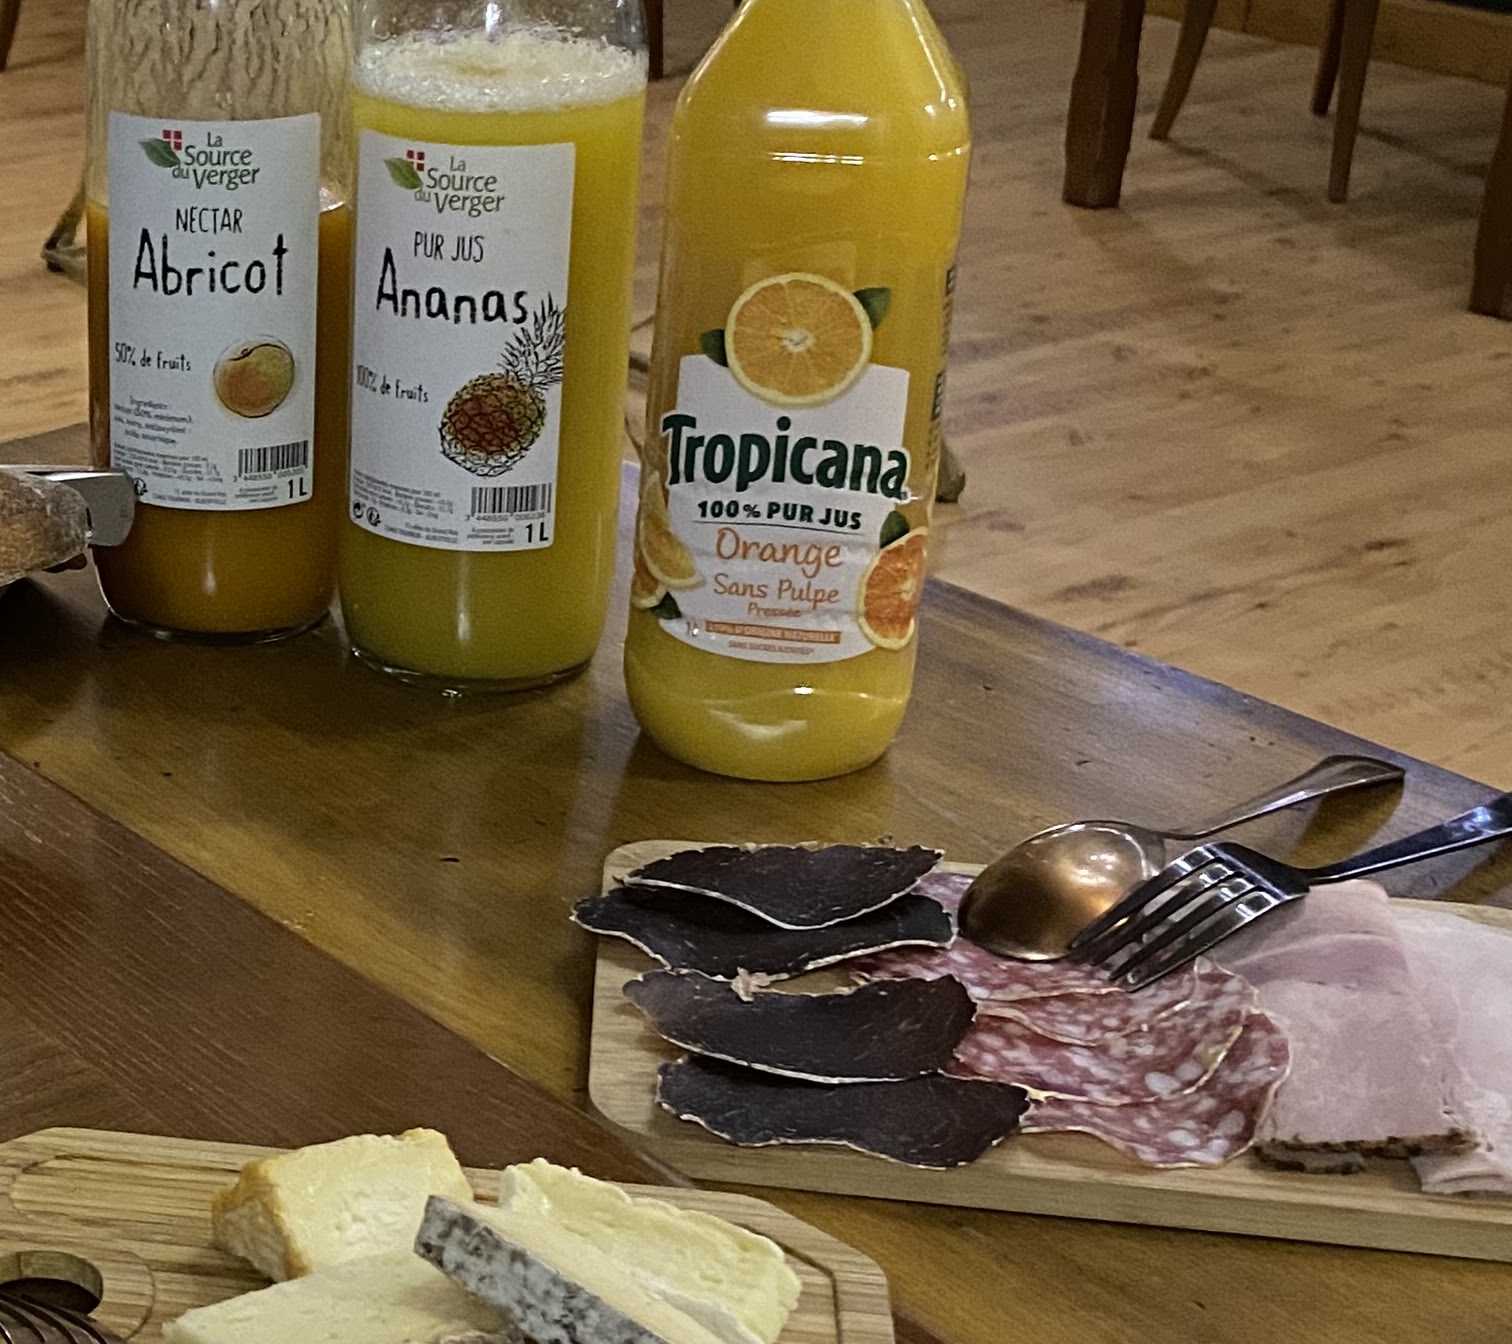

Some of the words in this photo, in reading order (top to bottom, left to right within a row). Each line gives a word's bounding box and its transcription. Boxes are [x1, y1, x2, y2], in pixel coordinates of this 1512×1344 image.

[207, 132, 222, 147] La
[185, 145, 252, 167] Source
[451, 156, 466, 171] La
[173, 166, 189, 180] du
[192, 166, 260, 190] Verger
[427, 169, 497, 192] Source
[415, 187, 431, 202] du
[436, 191, 505, 217] Verger
[176, 207, 242, 233] NECTAR
[414, 231, 443, 260] PUR
[452, 235, 484, 263] JUS
[133, 228, 288, 296] Abricot
[376, 247, 528, 324] Ananas
[115, 341, 136, 366] 50%
[140, 352, 152, 368] de
[155, 352, 191, 372] fruits
[380, 374, 391, 394] de
[396, 381, 428, 403] fruits
[663, 414, 909, 500] Tropicana
[288, 480, 293, 498] 1
[300, 477, 307, 496] L
[770, 503, 813, 523] PUR
[819, 509, 862, 530] JUS
[526, 525, 533, 543] 1
[540, 522, 548, 541] L
[716, 528, 845, 578] Orange
[713, 573, 768, 600] Sans
[778, 578, 841, 615] Pulpe
